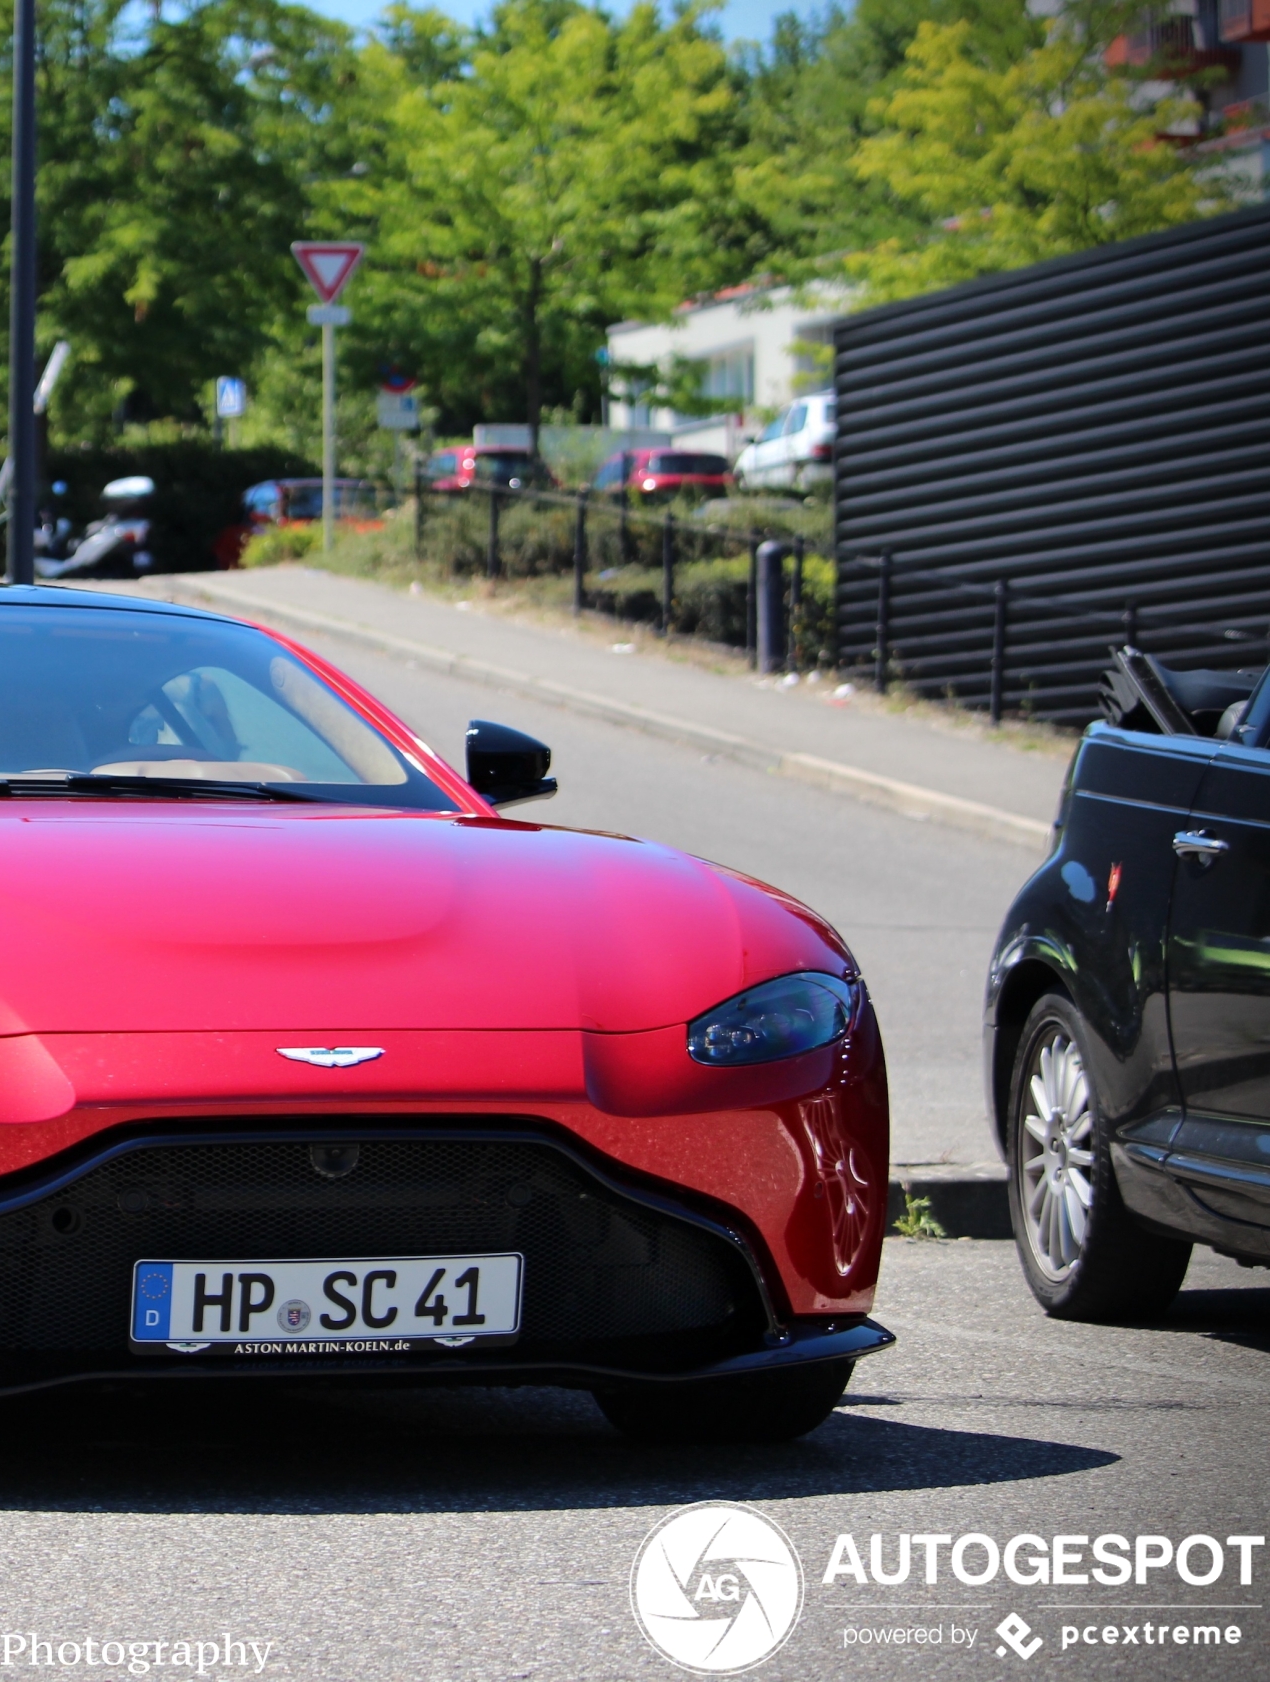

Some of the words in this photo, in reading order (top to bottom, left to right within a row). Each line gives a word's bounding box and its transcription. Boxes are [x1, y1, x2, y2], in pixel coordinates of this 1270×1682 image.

[192, 1273, 275, 1332] HP
[319, 1270, 398, 1330] SC
[414, 1267, 486, 1326] 41
[145, 1310, 160, 1326] D
[234, 1343, 280, 1354] ASTON
[285, 1340, 411, 1353] MARTIN-KOELN.de
